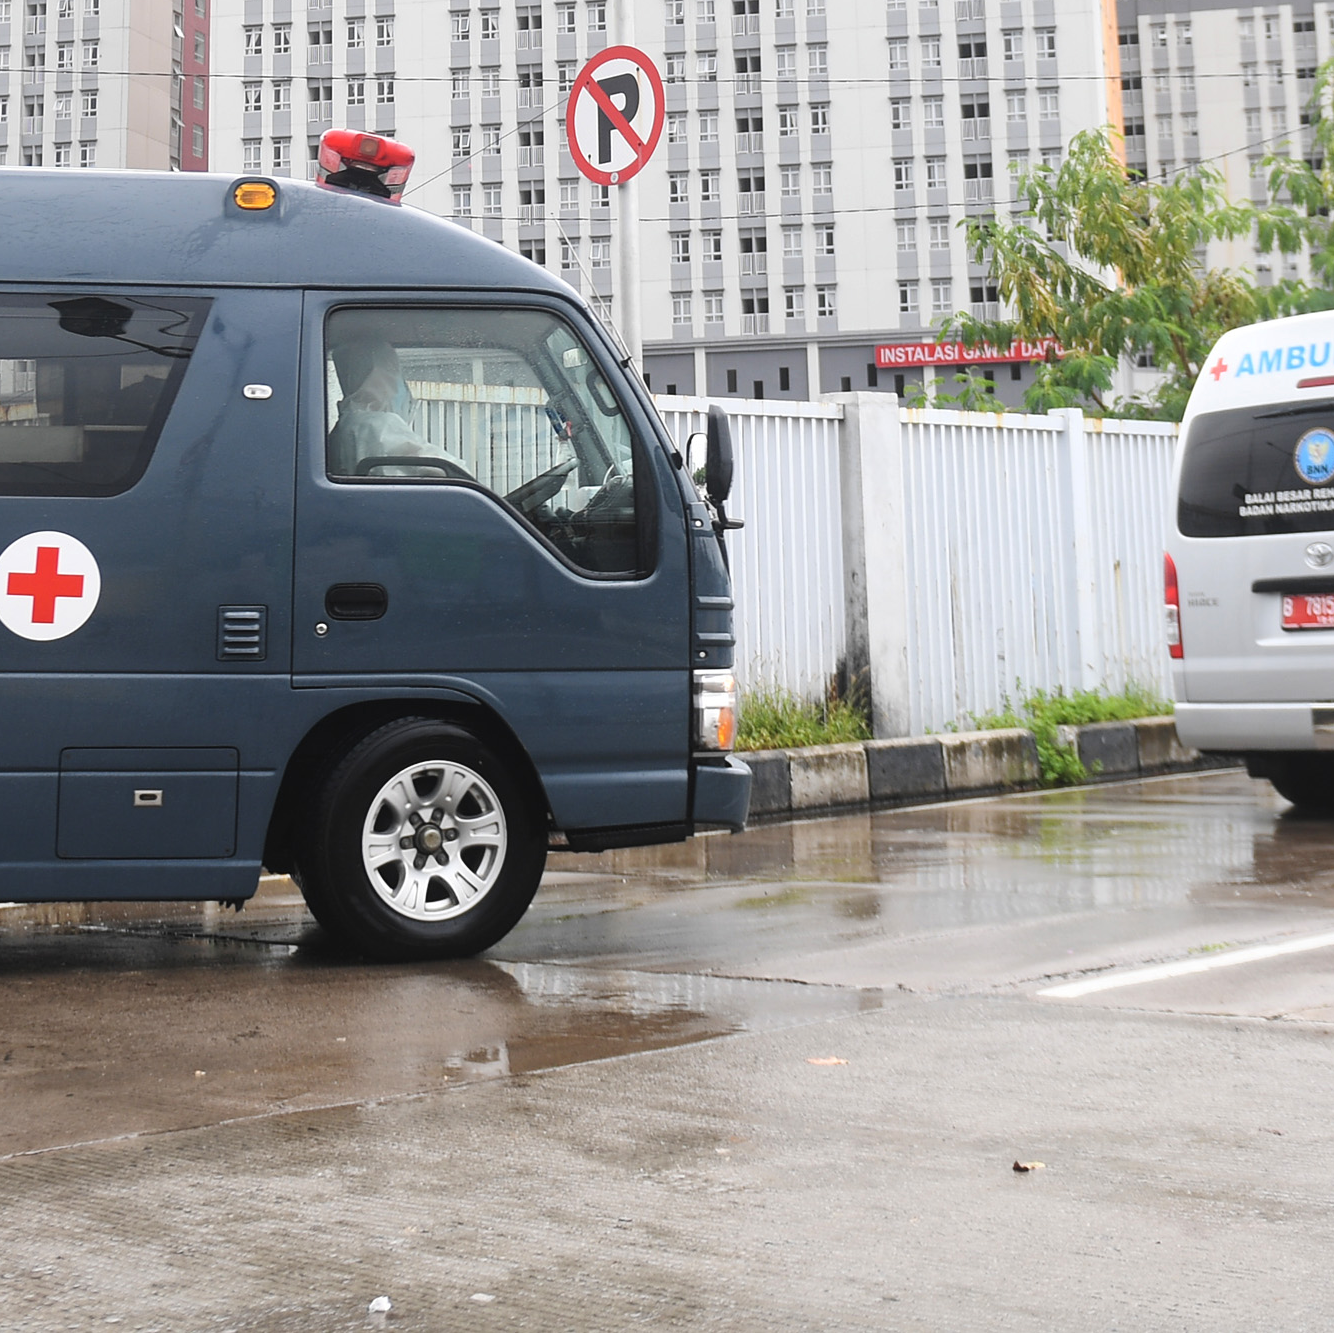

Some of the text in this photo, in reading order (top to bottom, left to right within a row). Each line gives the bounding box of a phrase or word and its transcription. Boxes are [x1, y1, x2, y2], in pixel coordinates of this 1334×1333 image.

[597, 73, 640, 164] P
[880, 345, 959, 363] INSTALASI
[1307, 465, 1329, 474] BNN
[1244, 492, 1275, 504] BALAI
[1276, 489, 1312, 502] BESAR
[1239, 504, 1274, 517] BADAN
[1283, 596, 1294, 617] B
